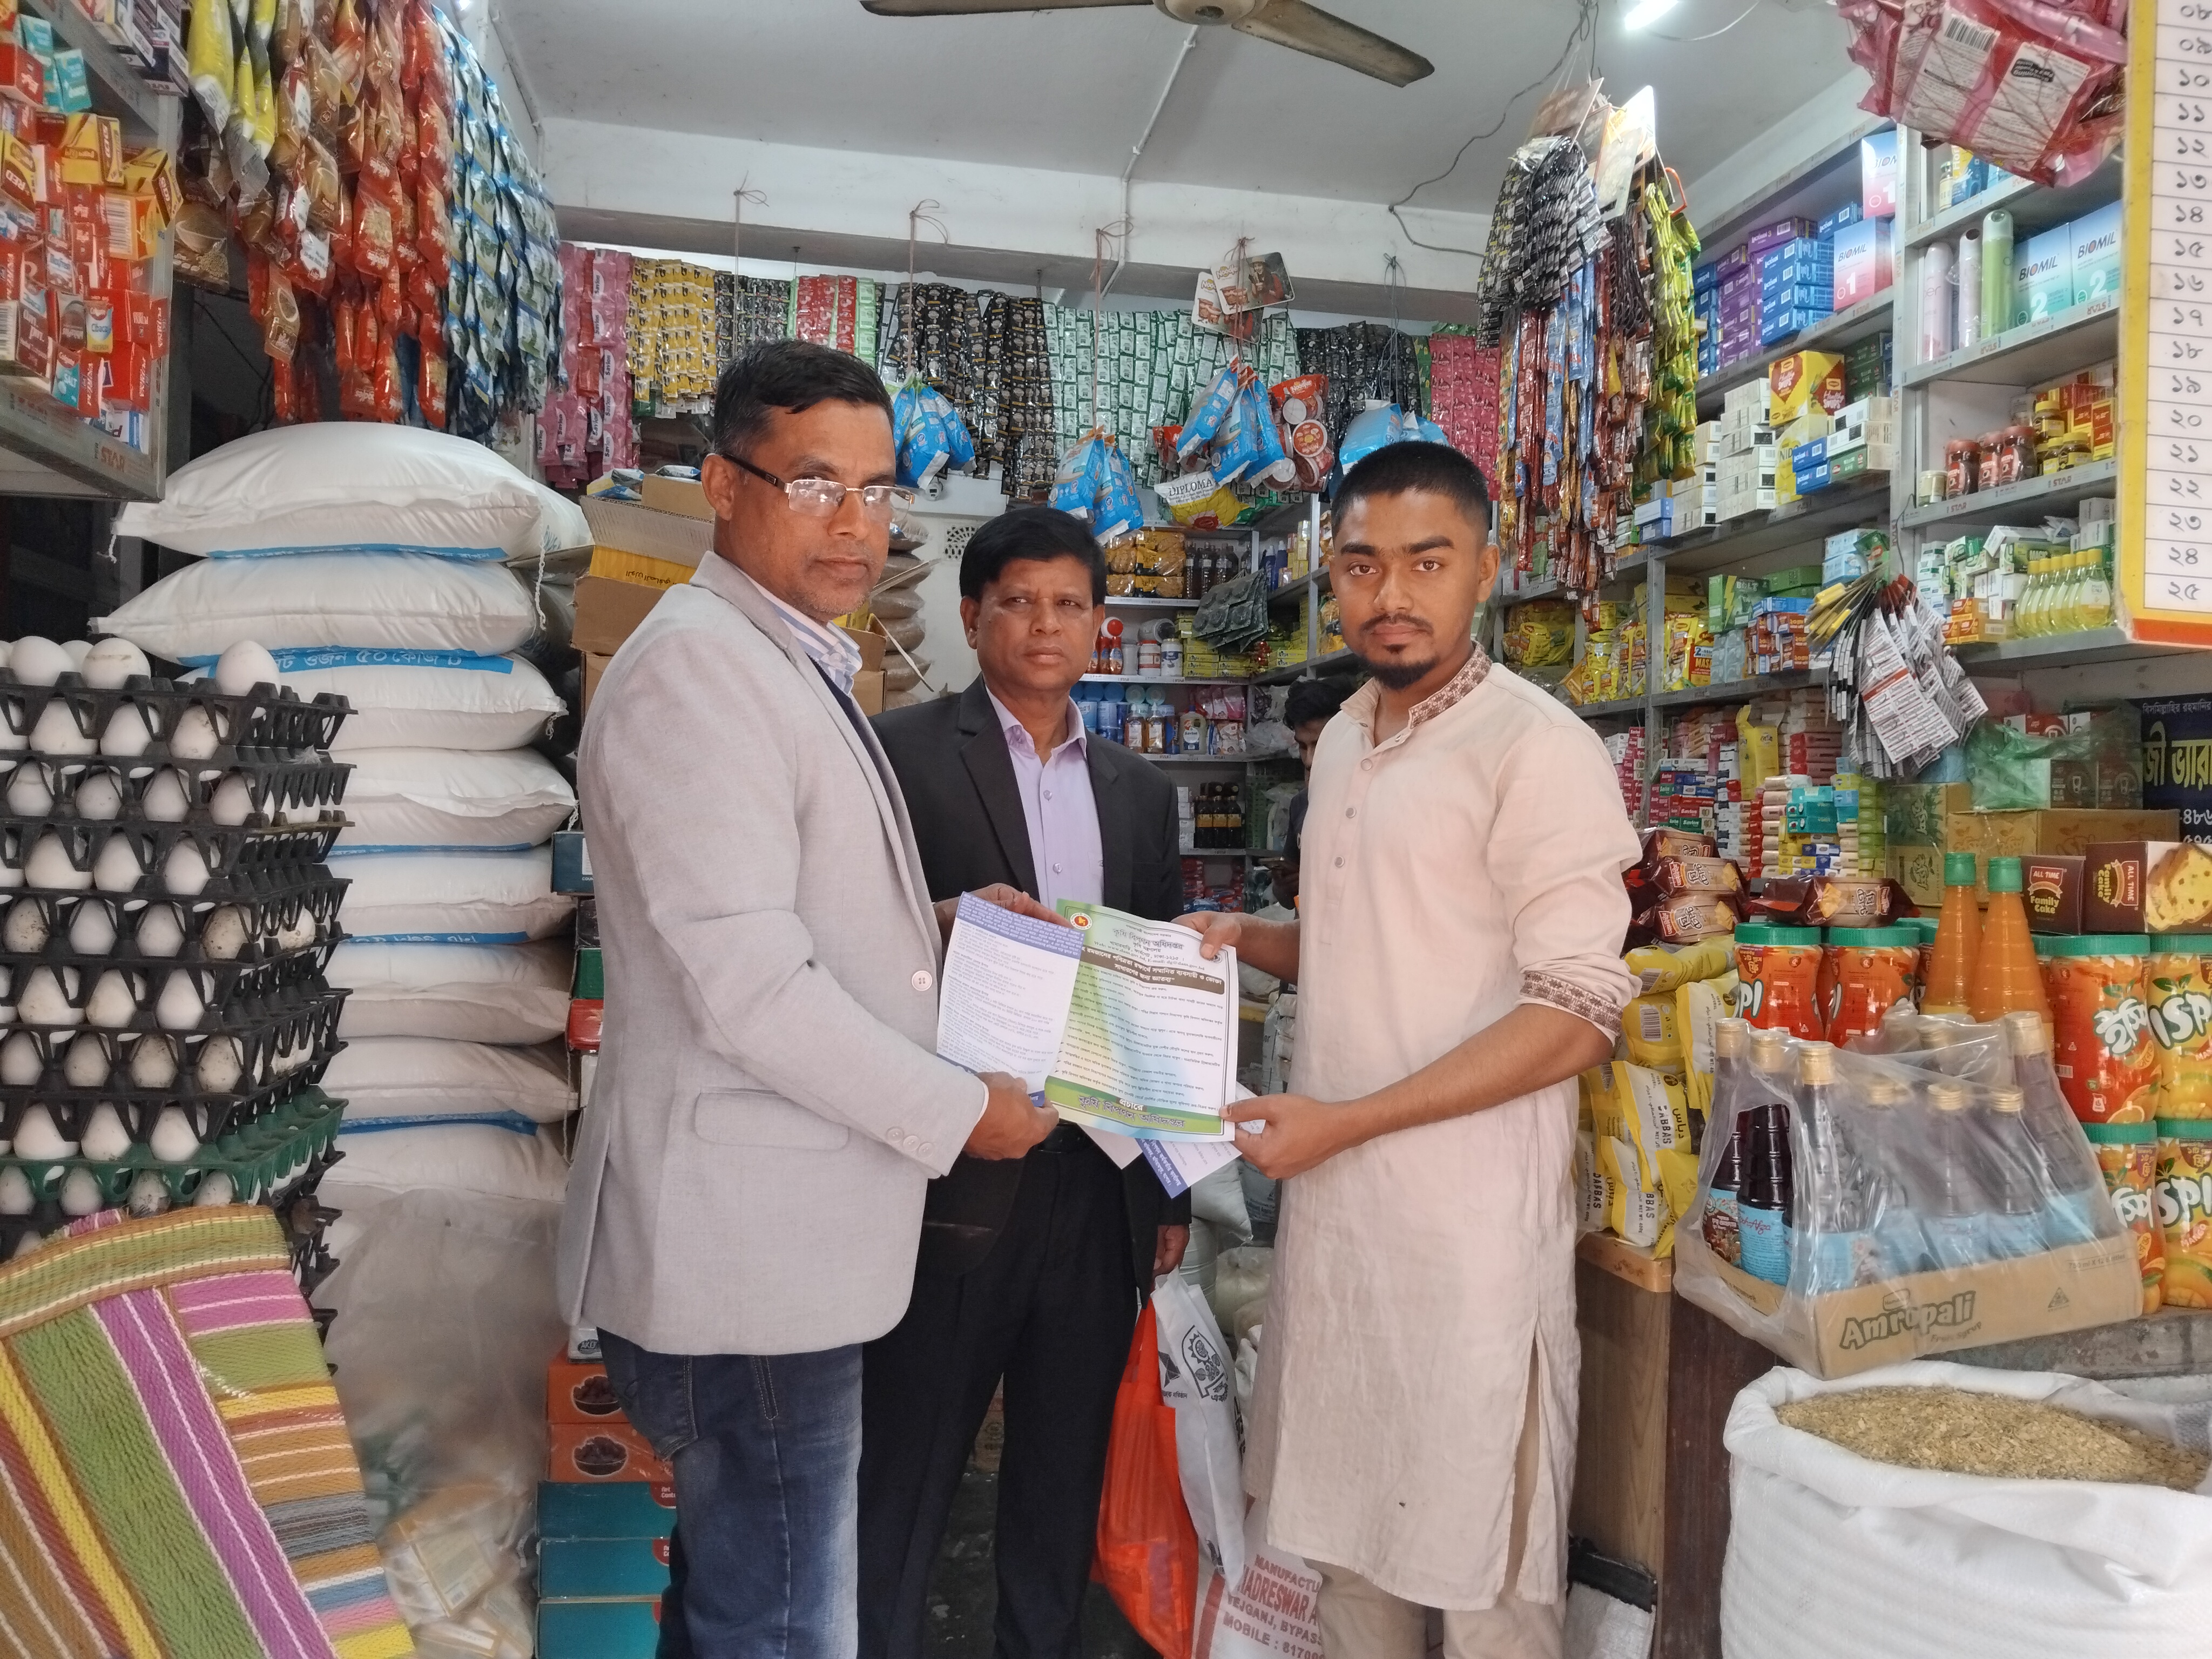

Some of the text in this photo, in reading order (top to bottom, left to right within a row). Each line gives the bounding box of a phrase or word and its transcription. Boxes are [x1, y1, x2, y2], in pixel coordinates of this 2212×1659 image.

[2179, 69, 2209, 87] ১০
[2178, 103, 2204, 123] ১১
[2177, 137, 2208, 158] ১২
[1872, 154, 1897, 169] BIOM
[2176, 170, 2207, 189] ১৩
[2175, 204, 2203, 223] ১৪
[1838, 244, 1866, 262] BIOMIL
[2078, 231, 2116, 259] BIOMIL
[2174, 238, 2205, 258] ১৫
[1216, 265, 1239, 280] Noodle
[2019, 255, 2058, 281] BIOMIL
[1846, 272, 1856, 295] 1
[2090, 269, 2107, 300] 2
[2174, 272, 2204, 292] ১৬
[2031, 292, 2048, 322] 2
[2087, 301, 2106, 315] STAR
[2173, 307, 2203, 327] ১৭
[2173, 341, 2204, 359] ১৮
[2172, 375, 2201, 394] ১৯
[2170, 409, 2202, 429] ২০
[2170, 443, 2198, 463] ২১
[1169, 478, 1213, 496] DIPLOMA
[2053, 475, 2072, 486] STAR
[2169, 478, 2202, 500] ২২
[1951, 502, 1967, 512] STAR
[2169, 512, 2202, 532] ২৩
[2029, 550, 2048, 561] MAGIC
[2168, 547, 2198, 567] ২৪
[1736, 579, 1758, 591] BOLT
[2168, 581, 2201, 601] ২৫
[356, 652, 388, 663] ৫০
[2045, 871, 2060, 879] TIME
[2102, 864, 2112, 903] Family
[2031, 896, 2060, 908] Family
[2034, 905, 2056, 914] Cake
[1113, 928, 1184, 950] কৃষি বিপণন অধিদপ্তর
[1094, 940, 1107, 948] Web:
[1108, 945, 1147, 962] www.dam.gov.bd,
[1166, 960, 1205, 971] dg@dam.gov.bd
[1087, 948, 1111, 960] রমজানের
[1112, 954, 1133, 966] পবিত্রতা
[1152, 966, 1175, 975] সম্মানিত
[1176, 968, 1198, 980] ব্যবসায়ী
[1205, 975, 1222, 986] ভোক্তা
[1114, 963, 1150, 981] সাধারণের জন্য
[2148, 992, 2212, 1048] ISP
[1078, 1094, 1186, 1128] কৃষি বিপণন অধিদপ্তর
[1119, 1097, 1144, 1111] প্রচারে
[1593, 1172, 1602, 1209] DABBAS
[2155, 1175, 2212, 1225] SPI
[1645, 1193, 1655, 1219] BBAS
[1739, 1216, 1771, 1235] ooh-Afza
[2180, 1223, 2208, 1247] MANGO
[1839, 1290, 1977, 1350] Amropali
[1255, 1554, 1320, 1593] MANUFACTU
[1238, 1564, 1310, 1621] ADRESWAR
[1227, 1594, 1277, 1630] TEJGANJ,
[1223, 1611, 1270, 1646] MOBILE
